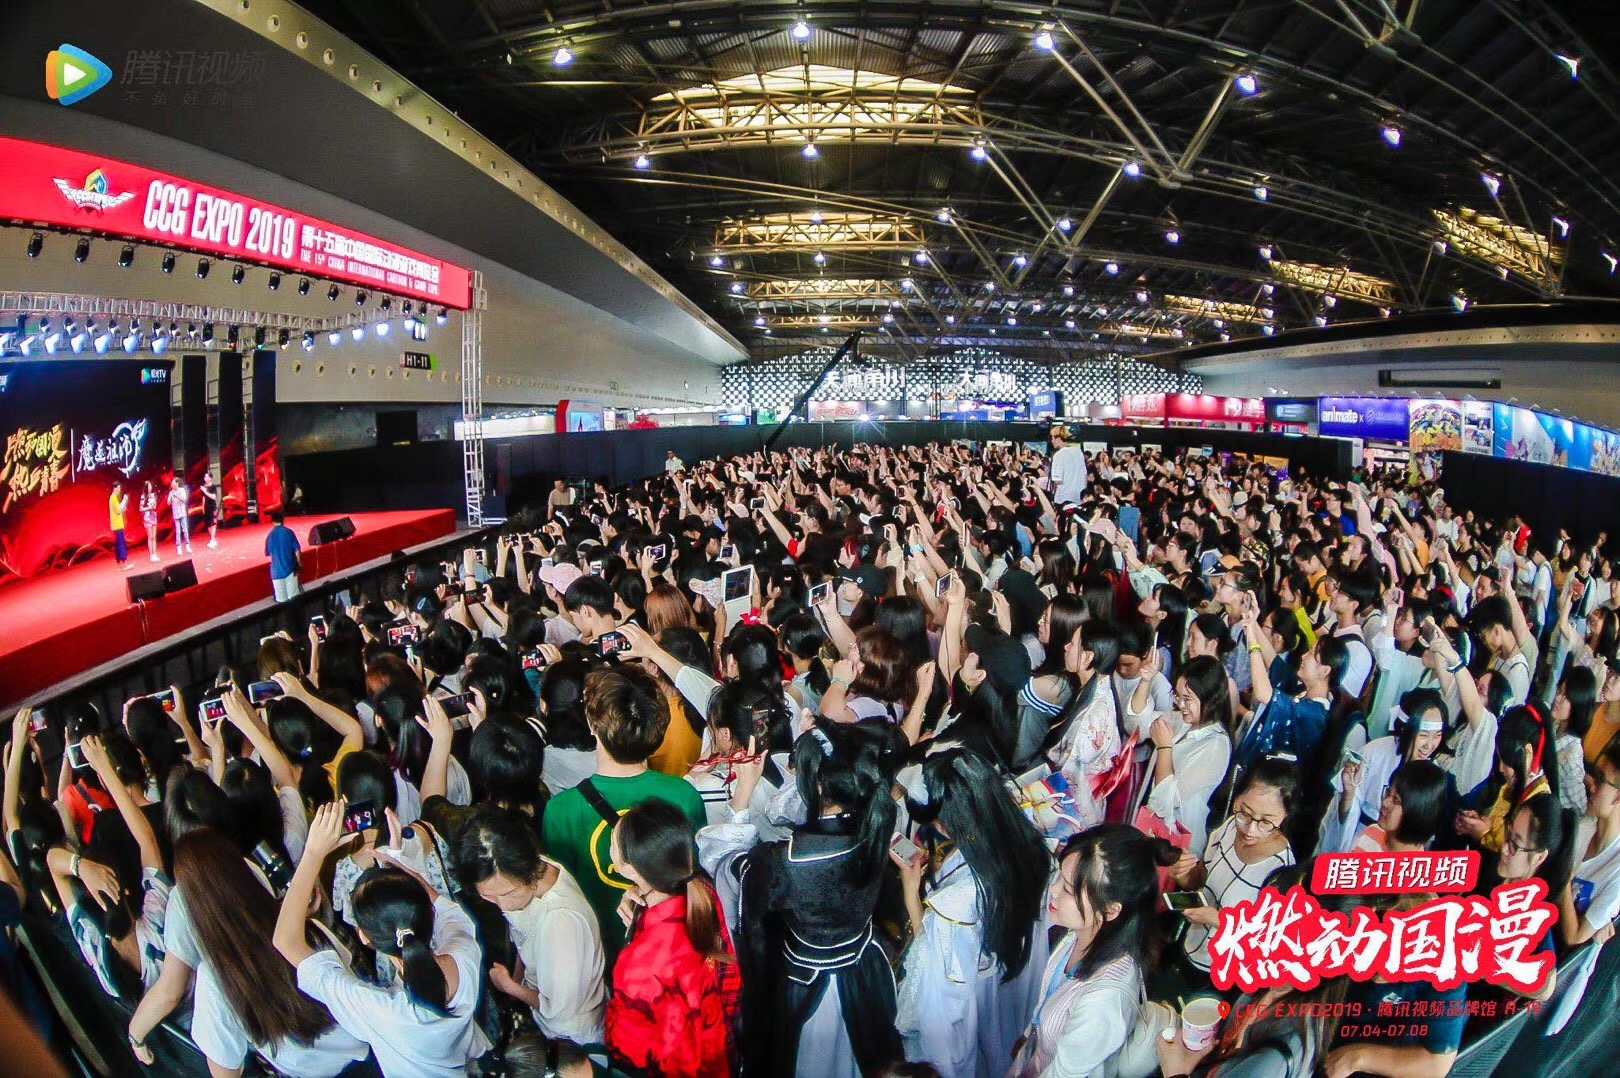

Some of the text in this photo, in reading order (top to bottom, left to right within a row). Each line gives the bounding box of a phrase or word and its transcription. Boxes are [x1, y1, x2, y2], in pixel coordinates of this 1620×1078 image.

[143, 180, 296, 259] CCG EXPO 2019
